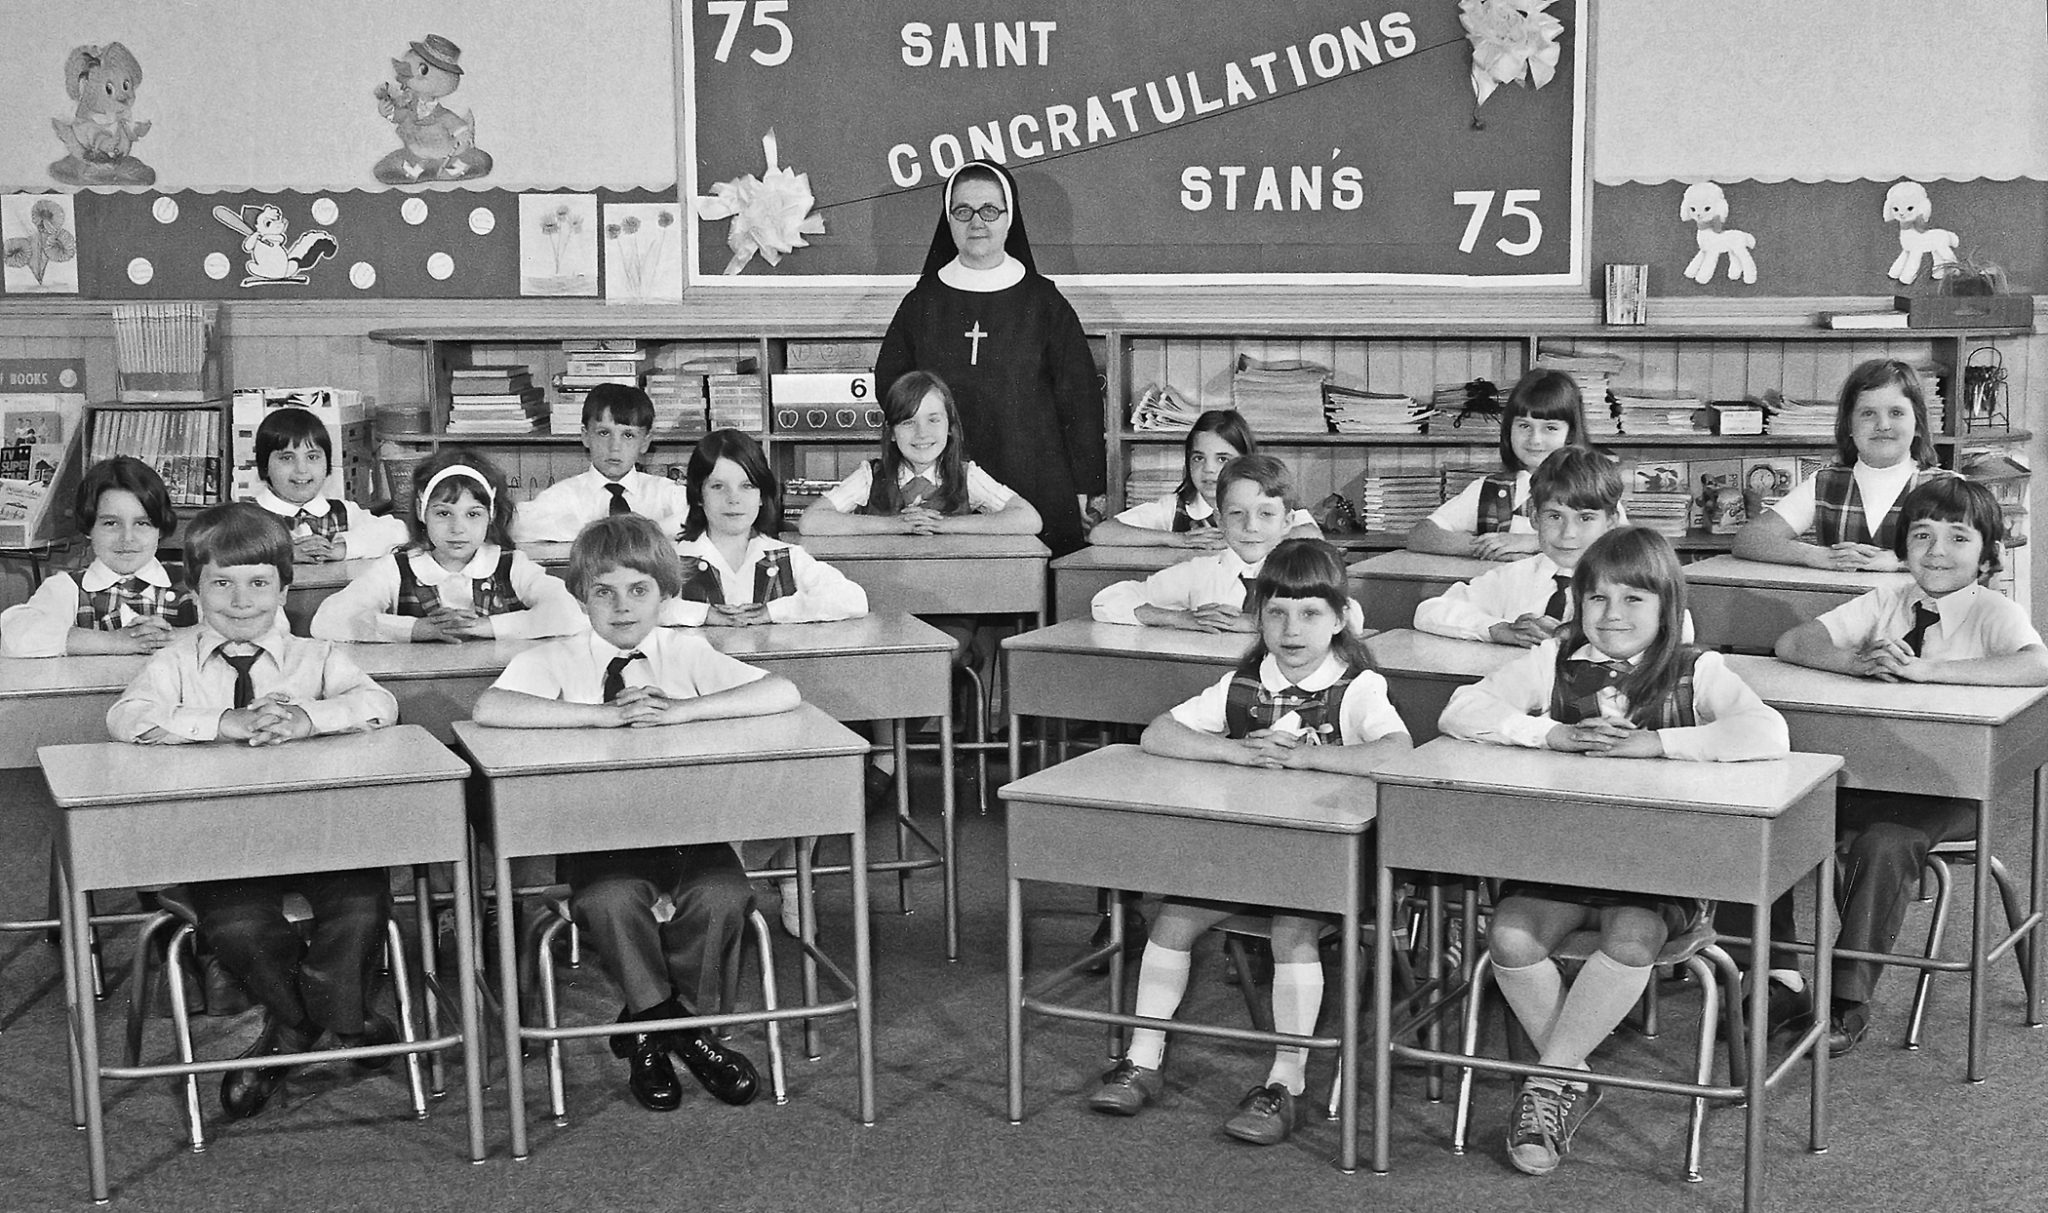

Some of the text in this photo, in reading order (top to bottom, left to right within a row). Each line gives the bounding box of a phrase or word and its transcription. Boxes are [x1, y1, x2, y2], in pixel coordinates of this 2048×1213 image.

[707, 0, 793, 66] 75
[900, 21, 1057, 69] SAINT
[887, 11, 1417, 188] CONGRATULATIONS
[1180, 148, 1365, 212] STAN'S
[1453, 189, 1543, 257] 75
[10, 372, 48, 385] BOOKS
[850, 377, 867, 399] 6
[2, 449, 15, 460] TV
